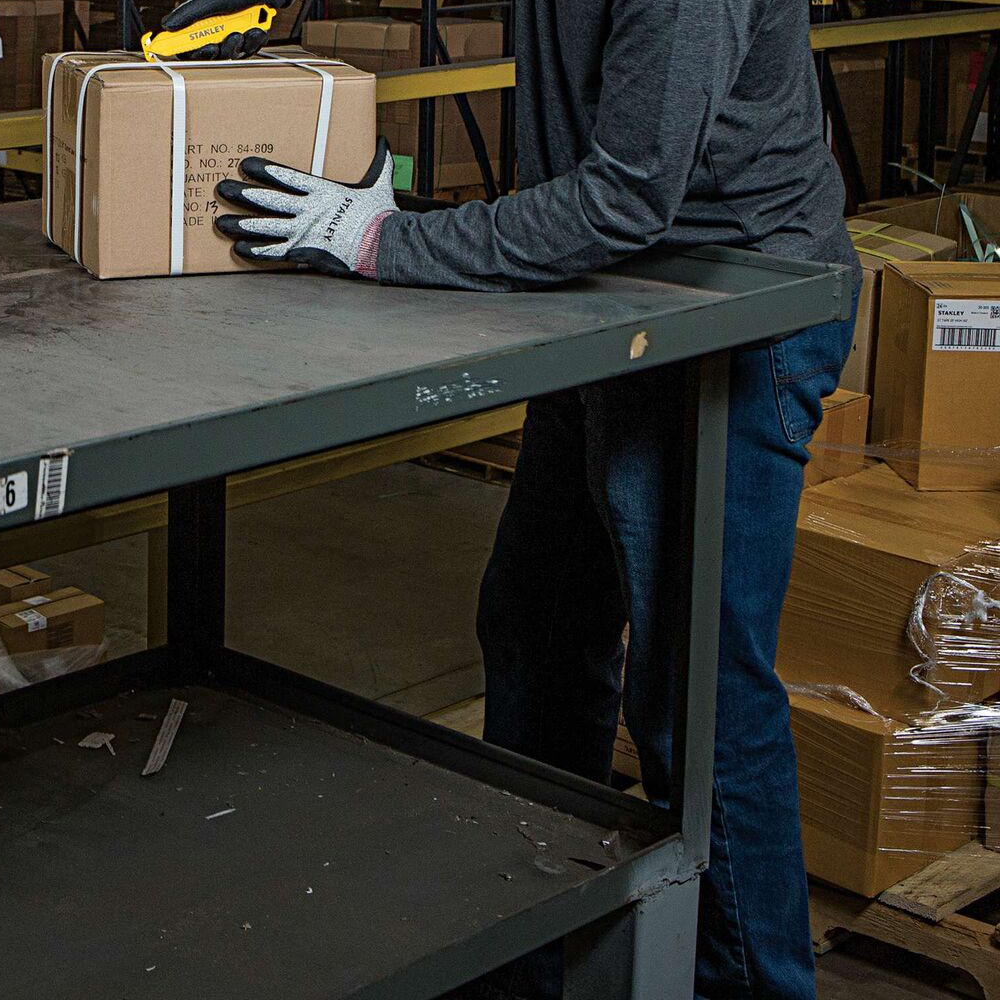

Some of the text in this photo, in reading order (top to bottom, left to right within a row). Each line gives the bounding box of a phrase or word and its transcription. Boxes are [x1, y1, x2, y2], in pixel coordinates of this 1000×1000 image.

[189, 24, 225, 41] STANLEY
[236, 143, 274, 154] 84-809
[323, 196, 353, 243] STANLEY
[5, 479, 16, 508] 6
